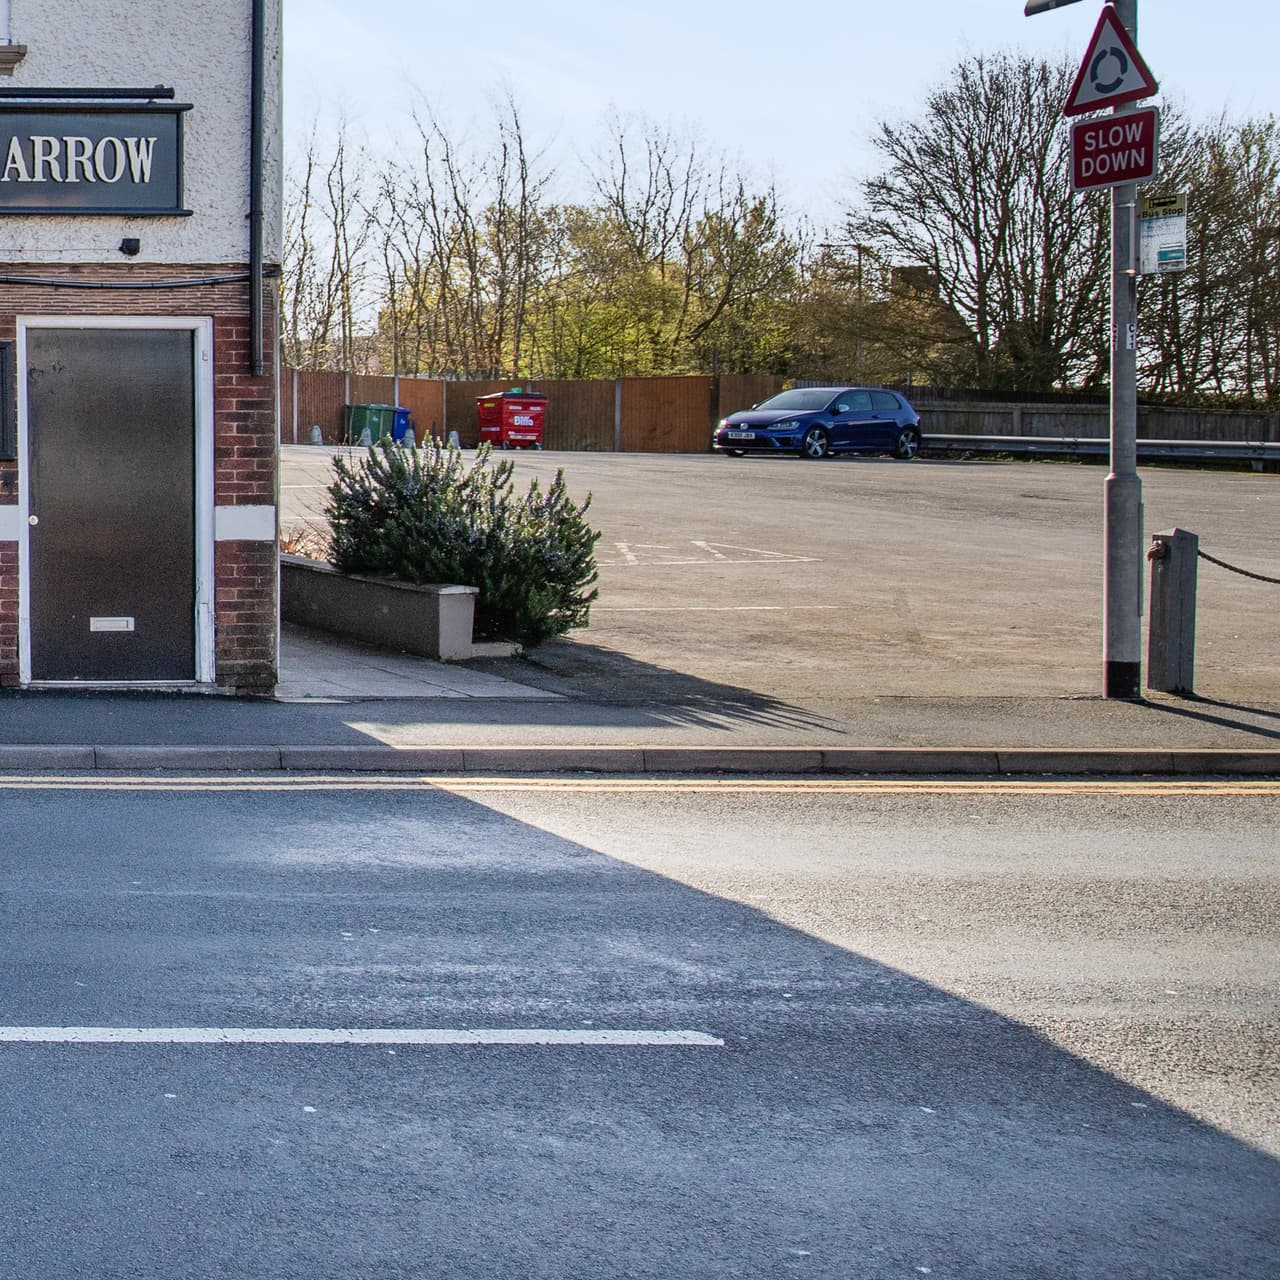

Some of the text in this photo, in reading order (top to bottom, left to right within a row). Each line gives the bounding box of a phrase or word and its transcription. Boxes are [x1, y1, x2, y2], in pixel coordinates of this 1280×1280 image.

[1084, 122, 1143, 151] SLOW
[1081, 147, 1145, 177] DOWN
[1162, 207, 1184, 216] Stop
